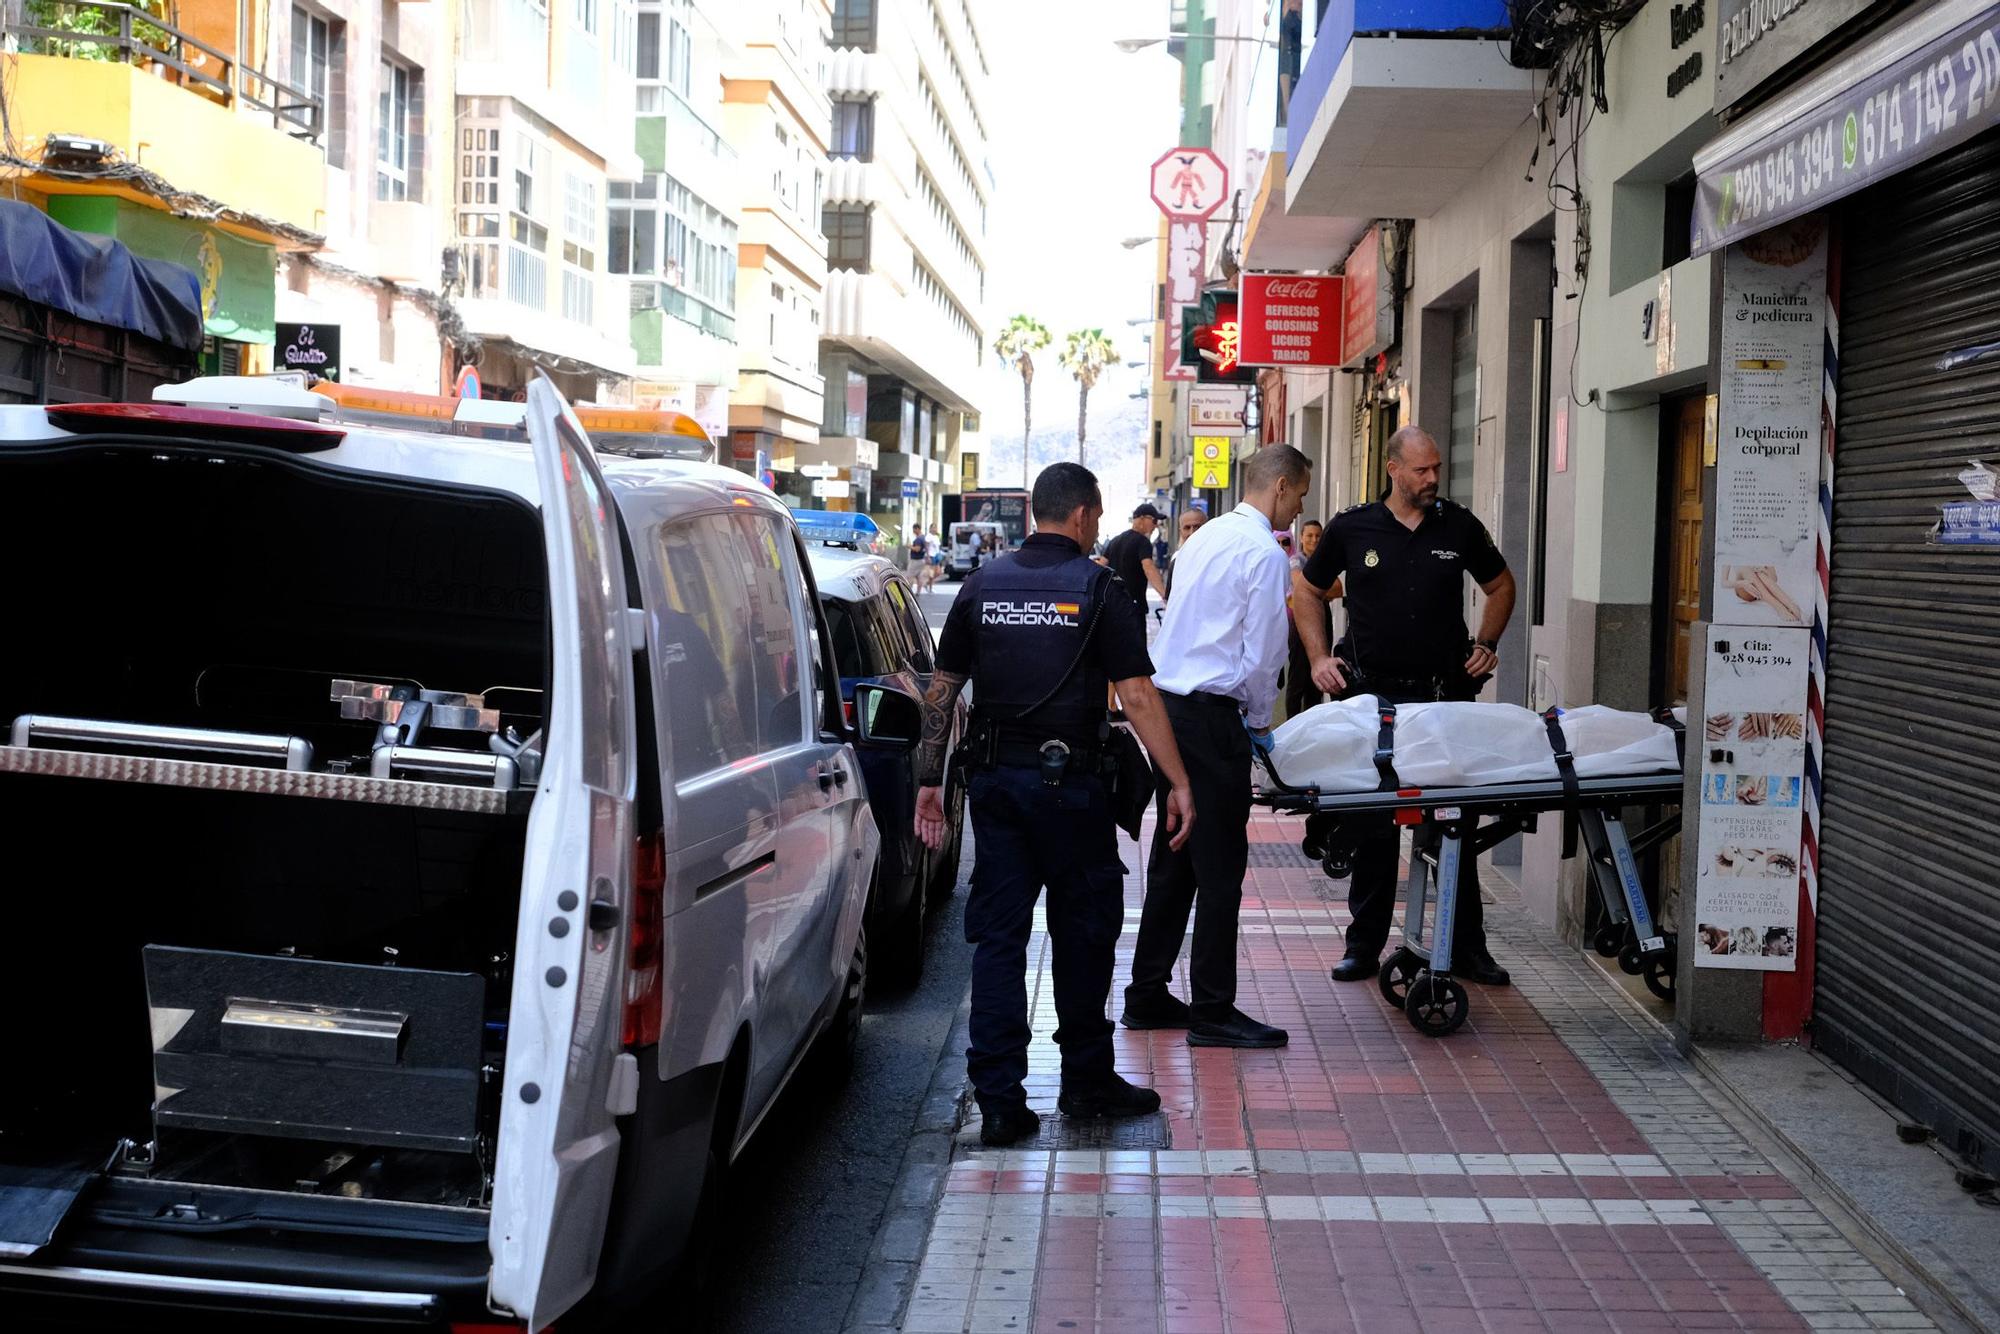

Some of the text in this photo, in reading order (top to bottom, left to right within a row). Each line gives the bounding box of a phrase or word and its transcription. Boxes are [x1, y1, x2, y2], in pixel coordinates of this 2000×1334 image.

[1721, 0, 1806, 65] PELUQU
[1731, 160, 1763, 225] 928
[1765, 146, 1796, 212] 945
[1800, 120, 1835, 196] 394
[1861, 93, 1905, 167] 674
[1912, 55, 1958, 145] 742
[1741, 293, 1808, 306] Manicura
[1264, 304, 1320, 318] REFRESCOS
[1735, 309, 1814, 324] & pedicura
[1264, 319, 1320, 333] GOLOSINAS
[1271, 335, 1312, 347] LICORES
[1272, 349, 1311, 362] TABACO
[1735, 426, 1808, 441] Depilación
[1741, 443, 1800, 457] corporal
[982, 602, 1058, 614] POLICIA
[981, 613, 1079, 627] NACIONAL
[1743, 640, 1772, 651] Cita:
[1722, 653, 1792, 666] 928 945 394
